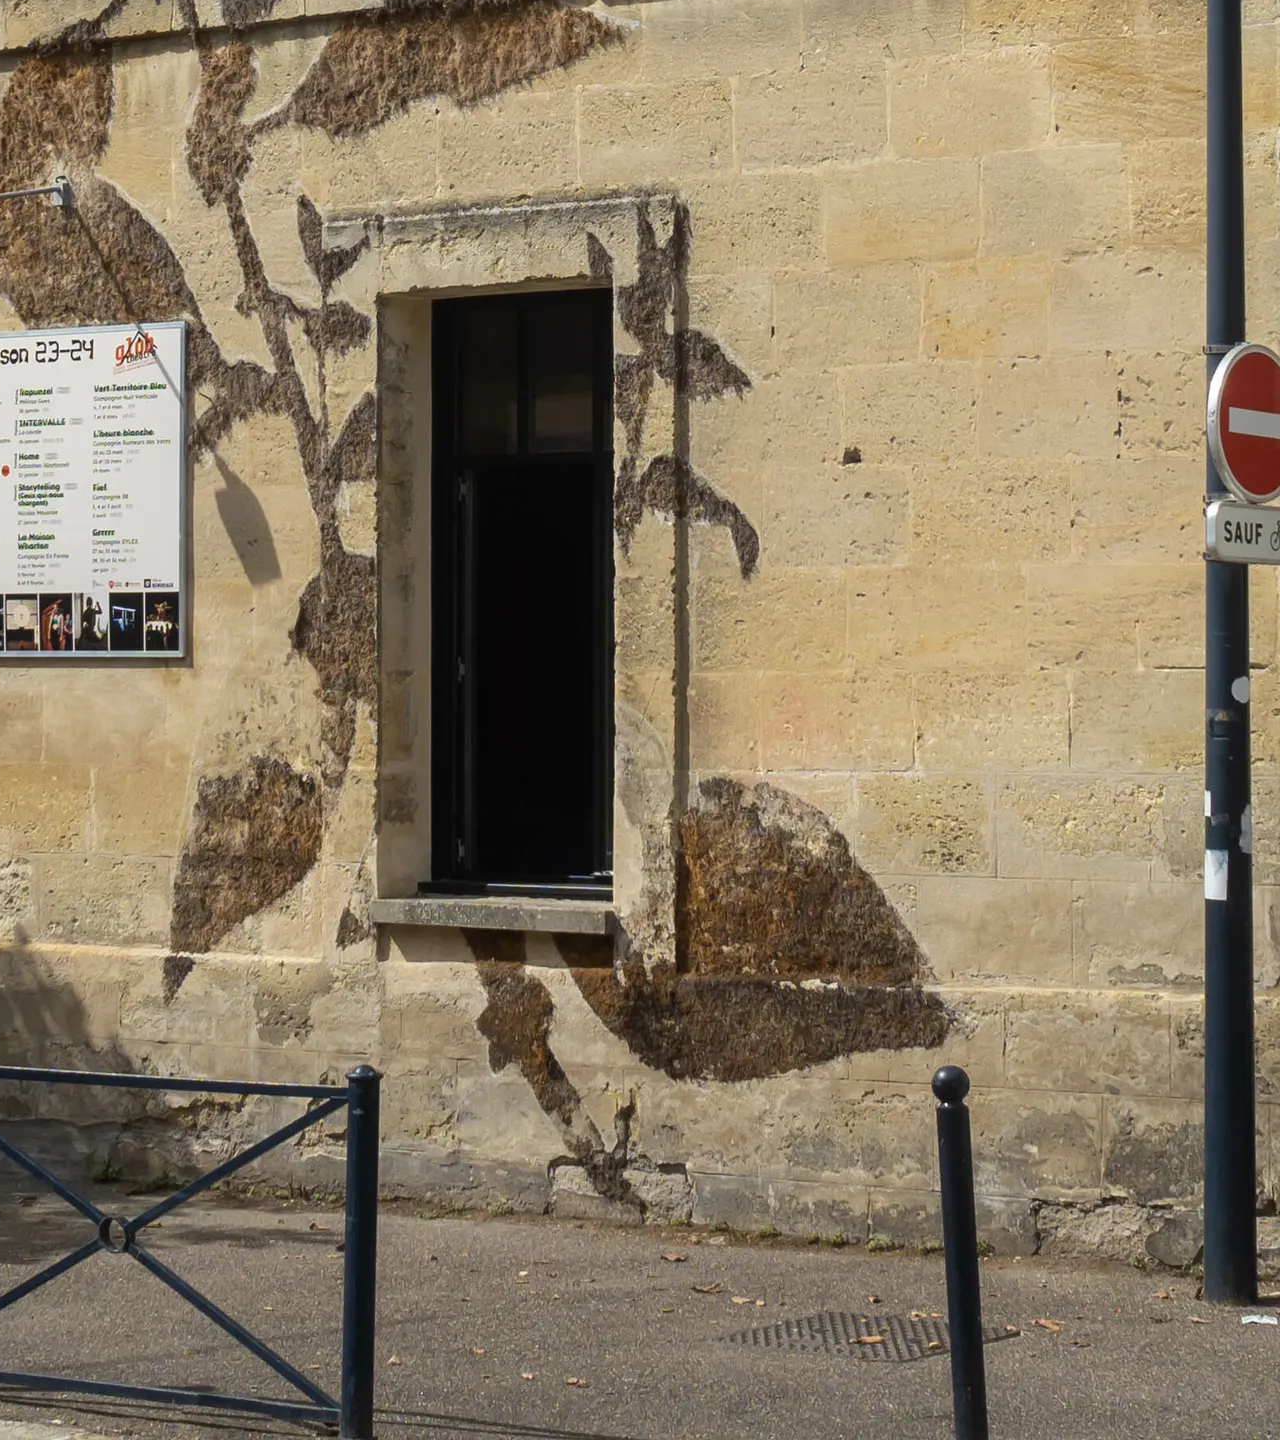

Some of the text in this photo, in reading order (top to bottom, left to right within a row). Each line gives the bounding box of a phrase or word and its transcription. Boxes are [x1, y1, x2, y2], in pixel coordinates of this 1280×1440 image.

[18, 482, 61, 492] Storytelling
[93, 483, 107, 491] Fief
[1224, 520, 1263, 545] SAUF
